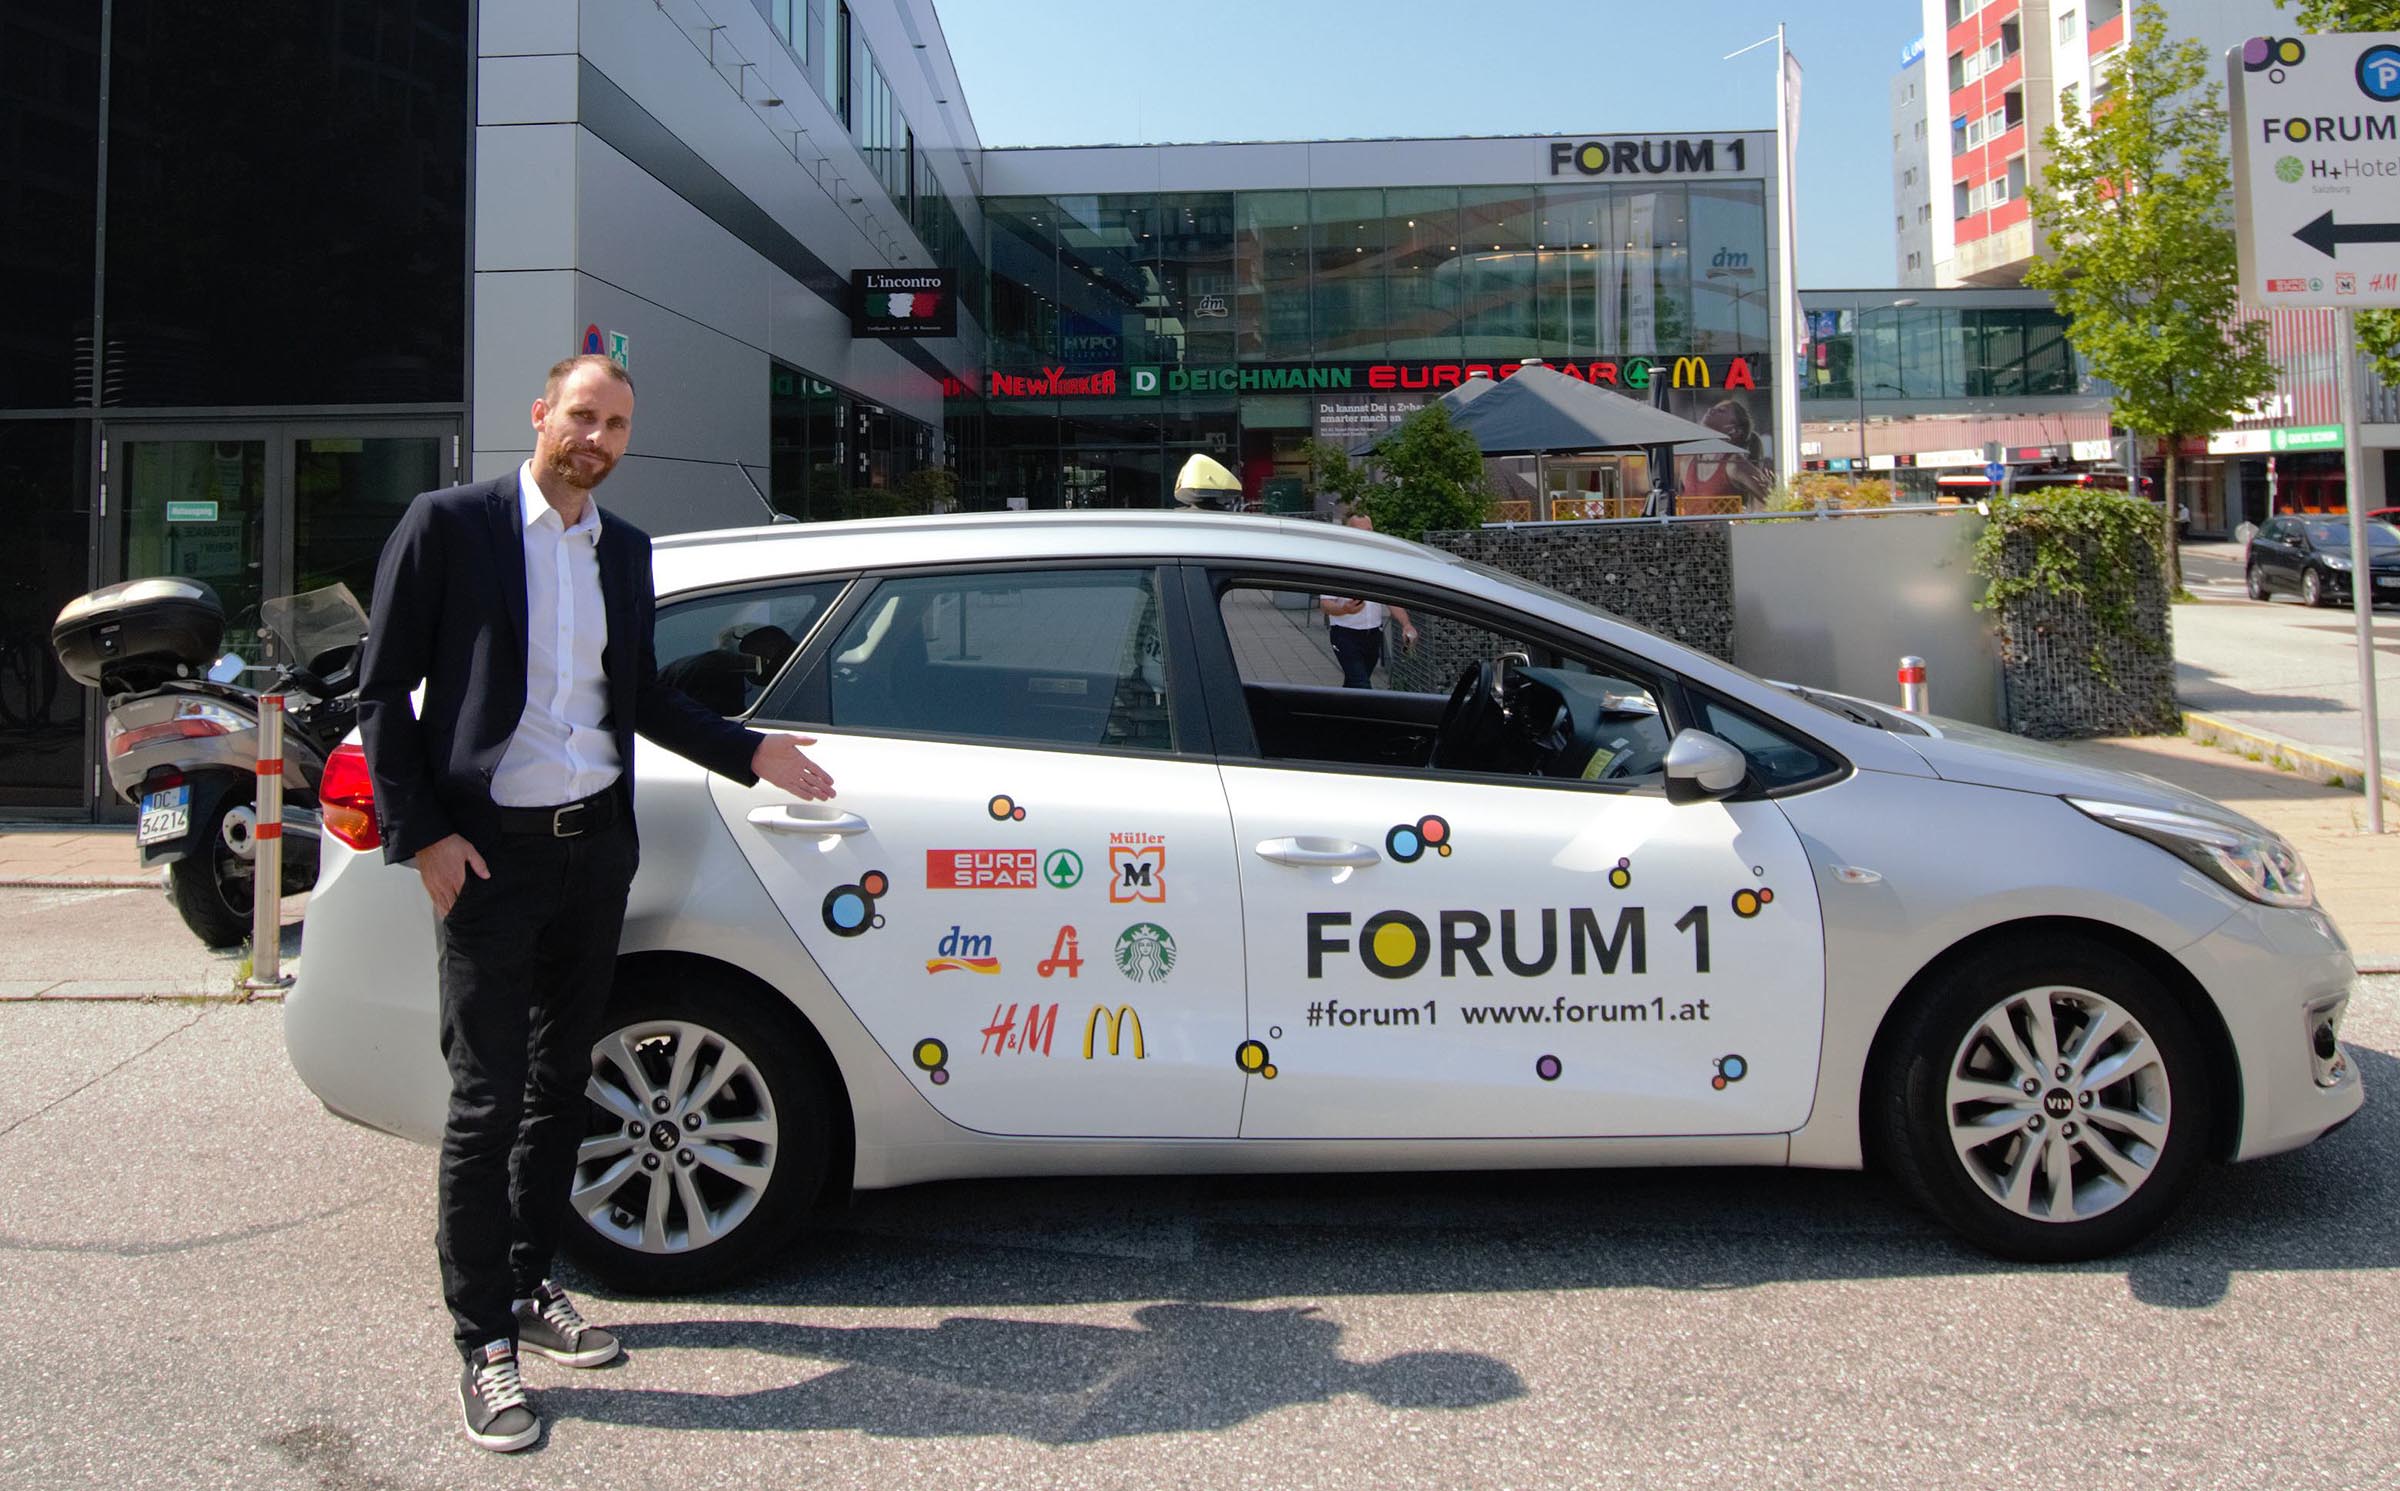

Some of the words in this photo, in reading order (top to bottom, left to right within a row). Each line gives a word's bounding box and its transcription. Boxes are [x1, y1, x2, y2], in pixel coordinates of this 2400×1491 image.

[2263, 115, 2397, 144] FORUM
[1551, 139, 1714, 175] FORUM
[1726, 138, 1745, 171] 1
[1711, 246, 1749, 267] dm
[866, 274, 942, 289] L'incontro
[1168, 367, 1352, 392] DEICHMANN
[1320, 403, 1334, 413] Du
[1336, 403, 1369, 413] kannst
[1320, 414, 1358, 423] smarter
[142, 808, 186, 835] 34214
[1109, 832, 1165, 844] Müller
[954, 853, 1035, 869] EURO
[954, 870, 1035, 886] SPAR
[1122, 863, 1152, 887] M
[938, 925, 992, 957] dm
[1306, 906, 1648, 979] FORUM
[1674, 905, 1711, 974] 1
[1306, 1000, 1437, 1027] #forum1
[1461, 996, 1711, 1025] www.forum1.at
[980, 1002, 1059, 1058] H&M
